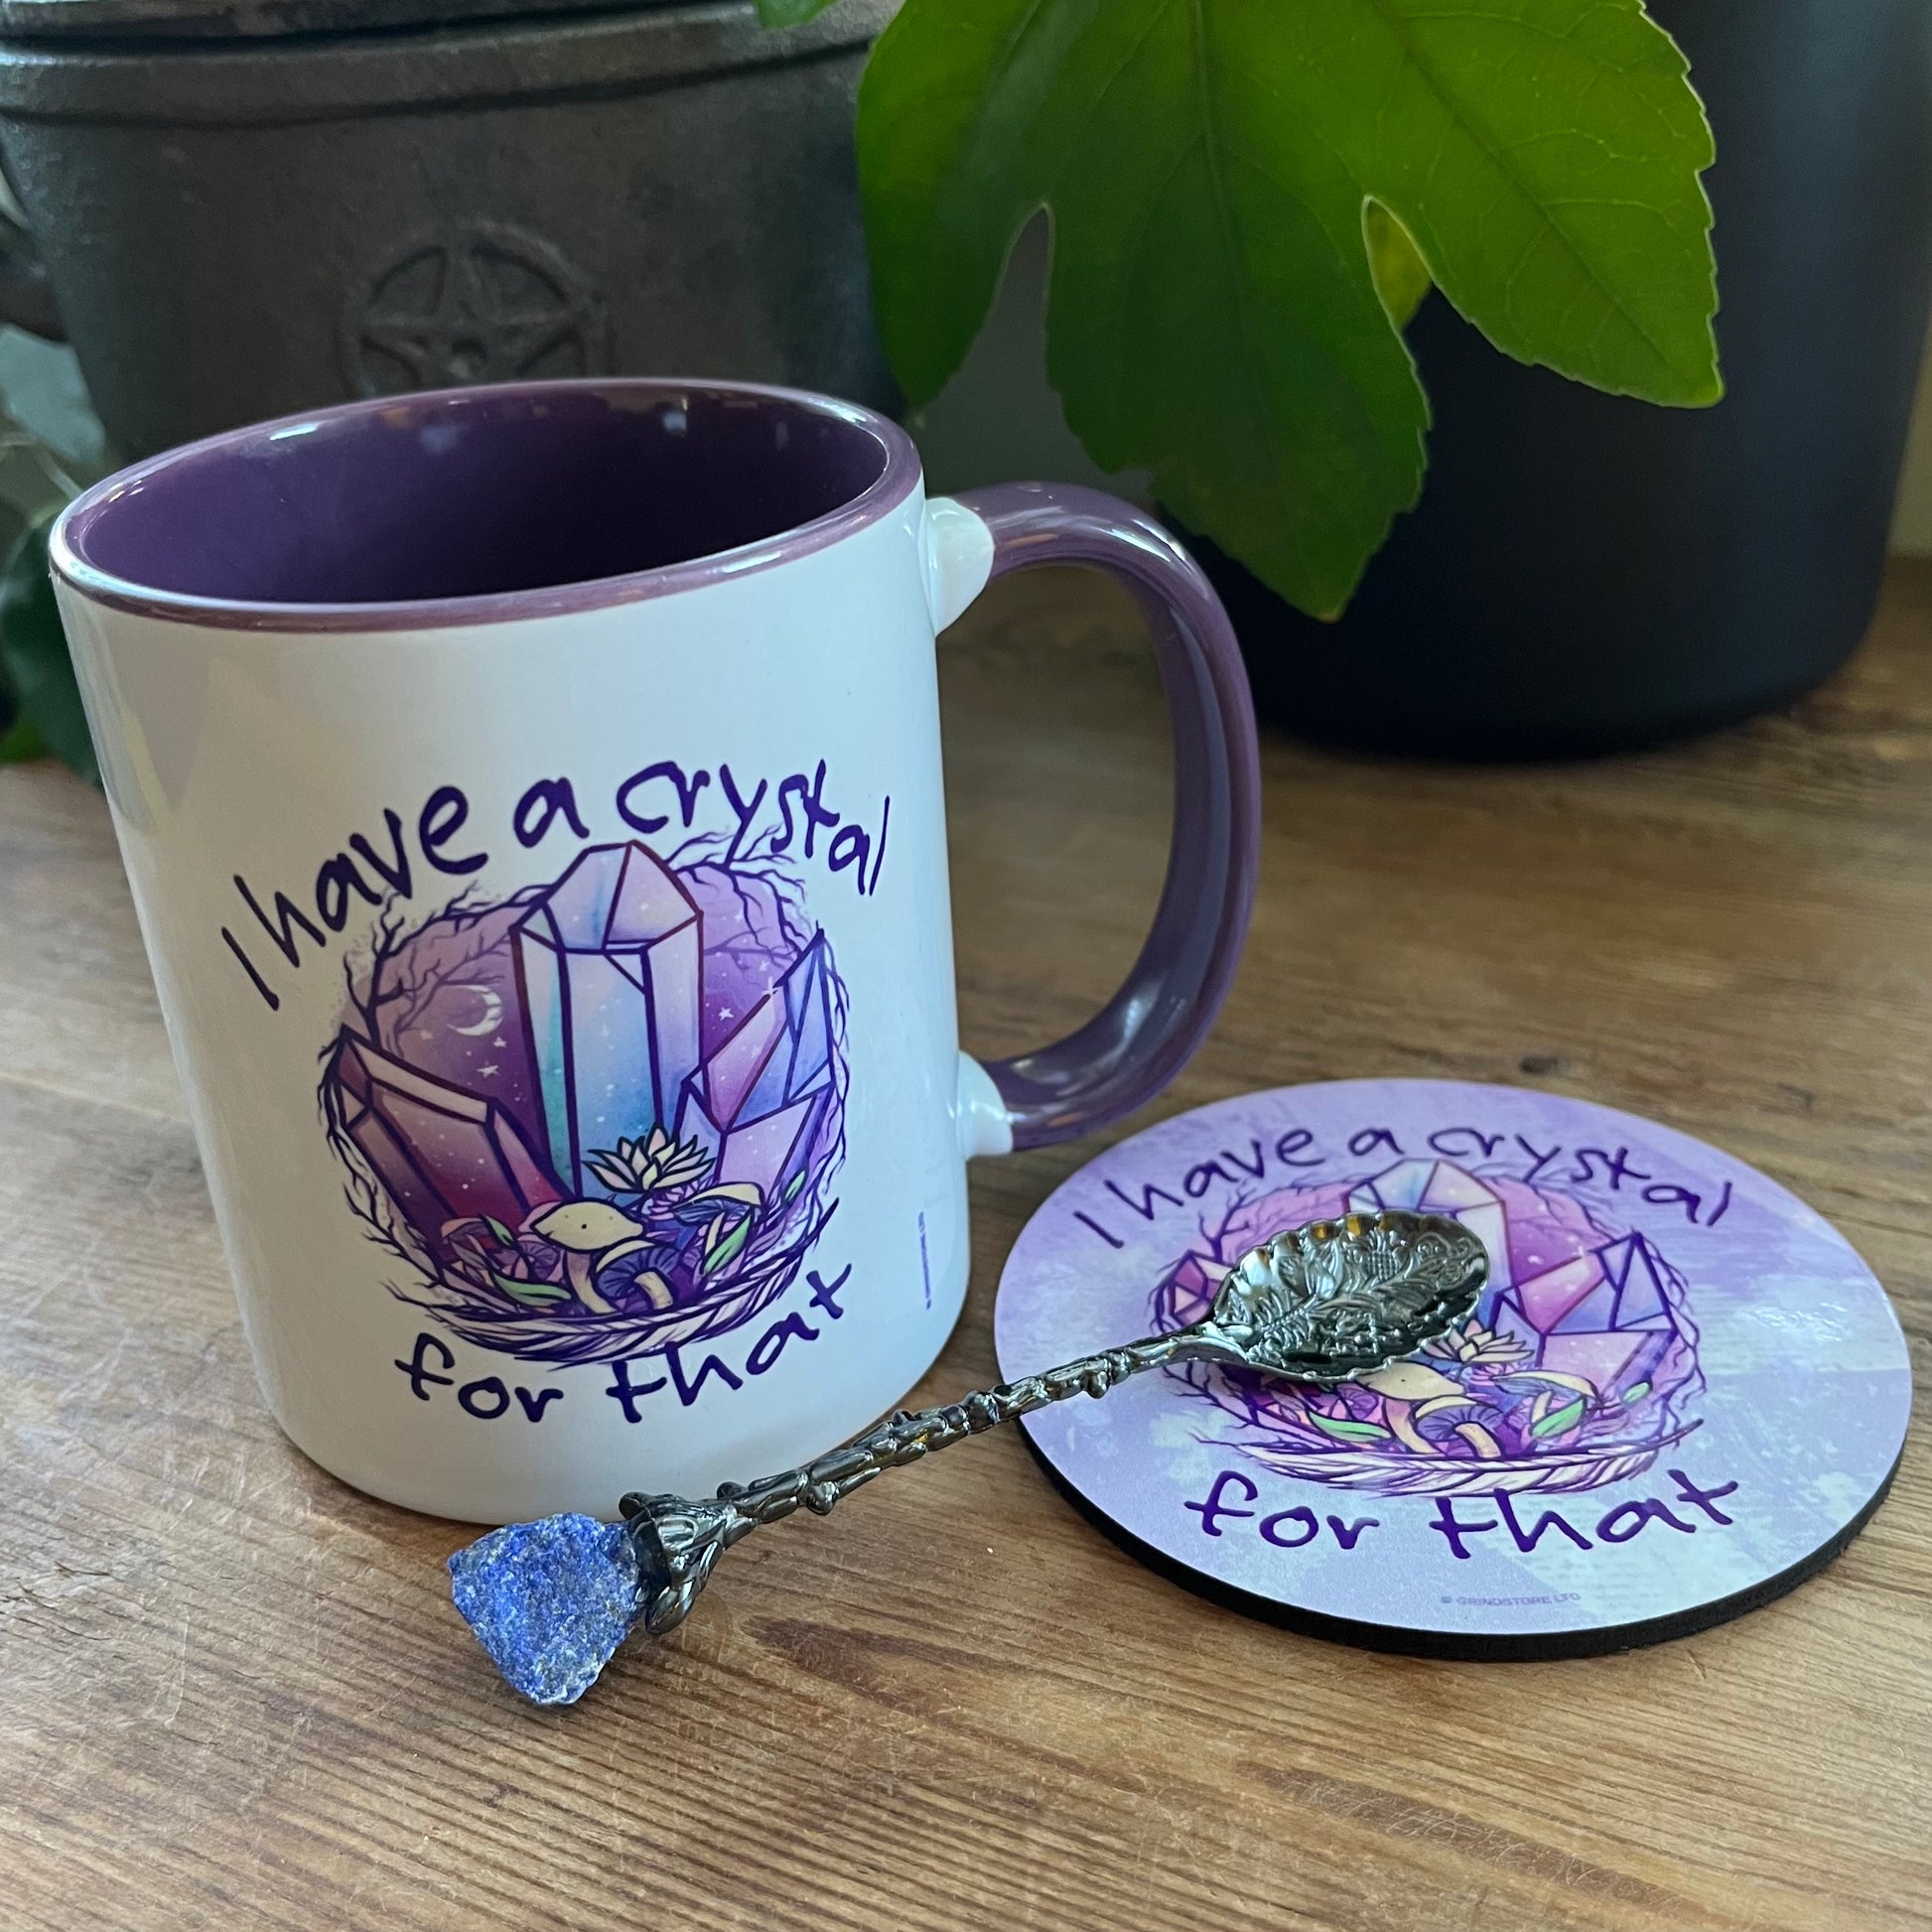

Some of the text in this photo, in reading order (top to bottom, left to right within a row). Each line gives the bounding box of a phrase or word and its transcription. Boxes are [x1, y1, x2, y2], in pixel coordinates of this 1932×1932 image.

[221, 759, 892, 1012] I have a crystal
[1073, 1127, 1732, 1250] I have a crystal
[395, 1263, 854, 1424] for that
[1184, 1468, 1740, 1560] for that
[1455, 1595, 1553, 1606] GRINDSTORE
[1554, 1592, 1582, 1602] LTD
